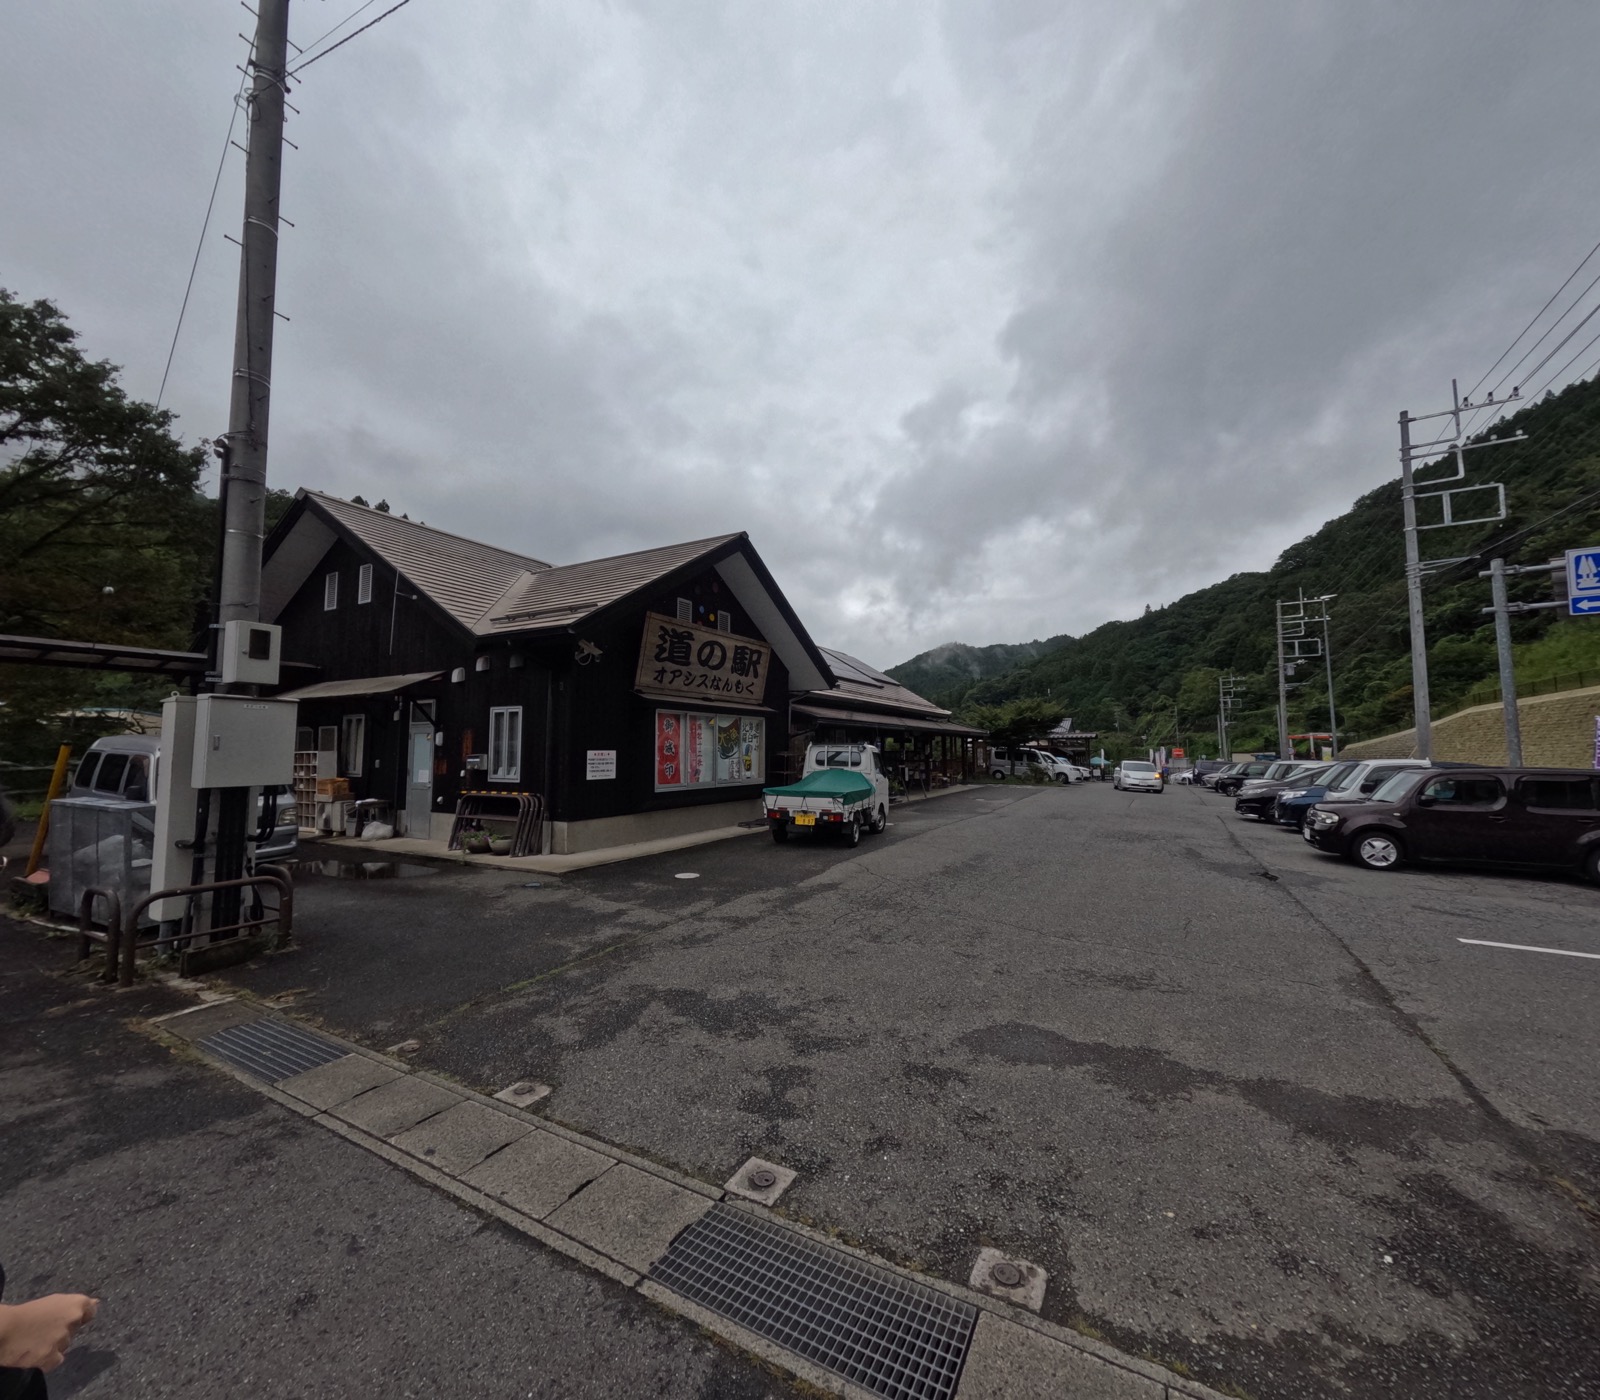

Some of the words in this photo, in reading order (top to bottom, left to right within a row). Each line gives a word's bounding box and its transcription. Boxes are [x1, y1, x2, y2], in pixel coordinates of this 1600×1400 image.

[655, 625, 762, 679] 道の駅
[653, 667, 755, 695] オアシスなんもく
